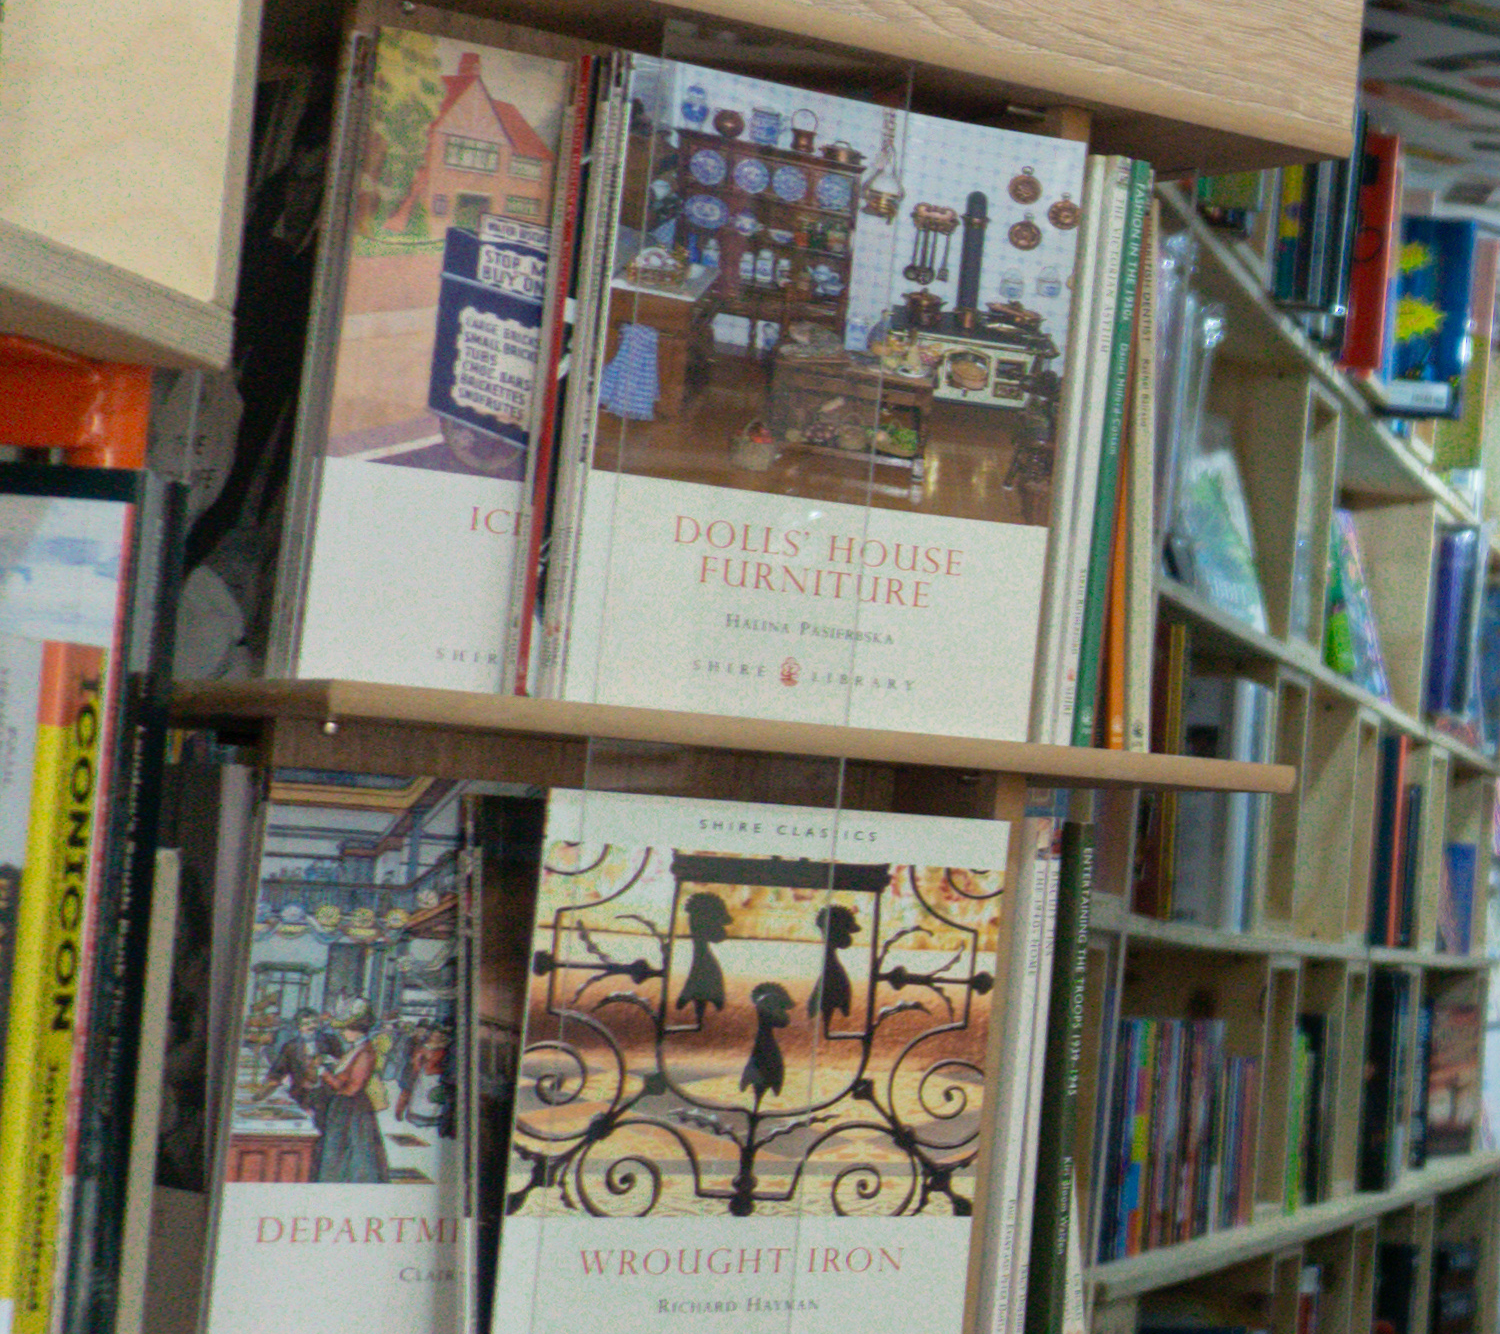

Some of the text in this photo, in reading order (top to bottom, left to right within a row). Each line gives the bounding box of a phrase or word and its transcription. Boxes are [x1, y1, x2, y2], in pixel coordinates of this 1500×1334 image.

[483, 247, 522, 270] STOP
[482, 266, 516, 287] BUY
[673, 514, 966, 579] DOLLS' HOUSE
[699, 555, 932, 610] FURNITURE
[726, 613, 789, 636] HALINA
[692, 659, 917, 693] SHIRE LIBRARY
[698, 817, 879, 842] SHIRE CLASSICS
[580, 1245, 905, 1278] WROUGHT IRON
[658, 1296, 819, 1314] RICHARD HAYMAN
